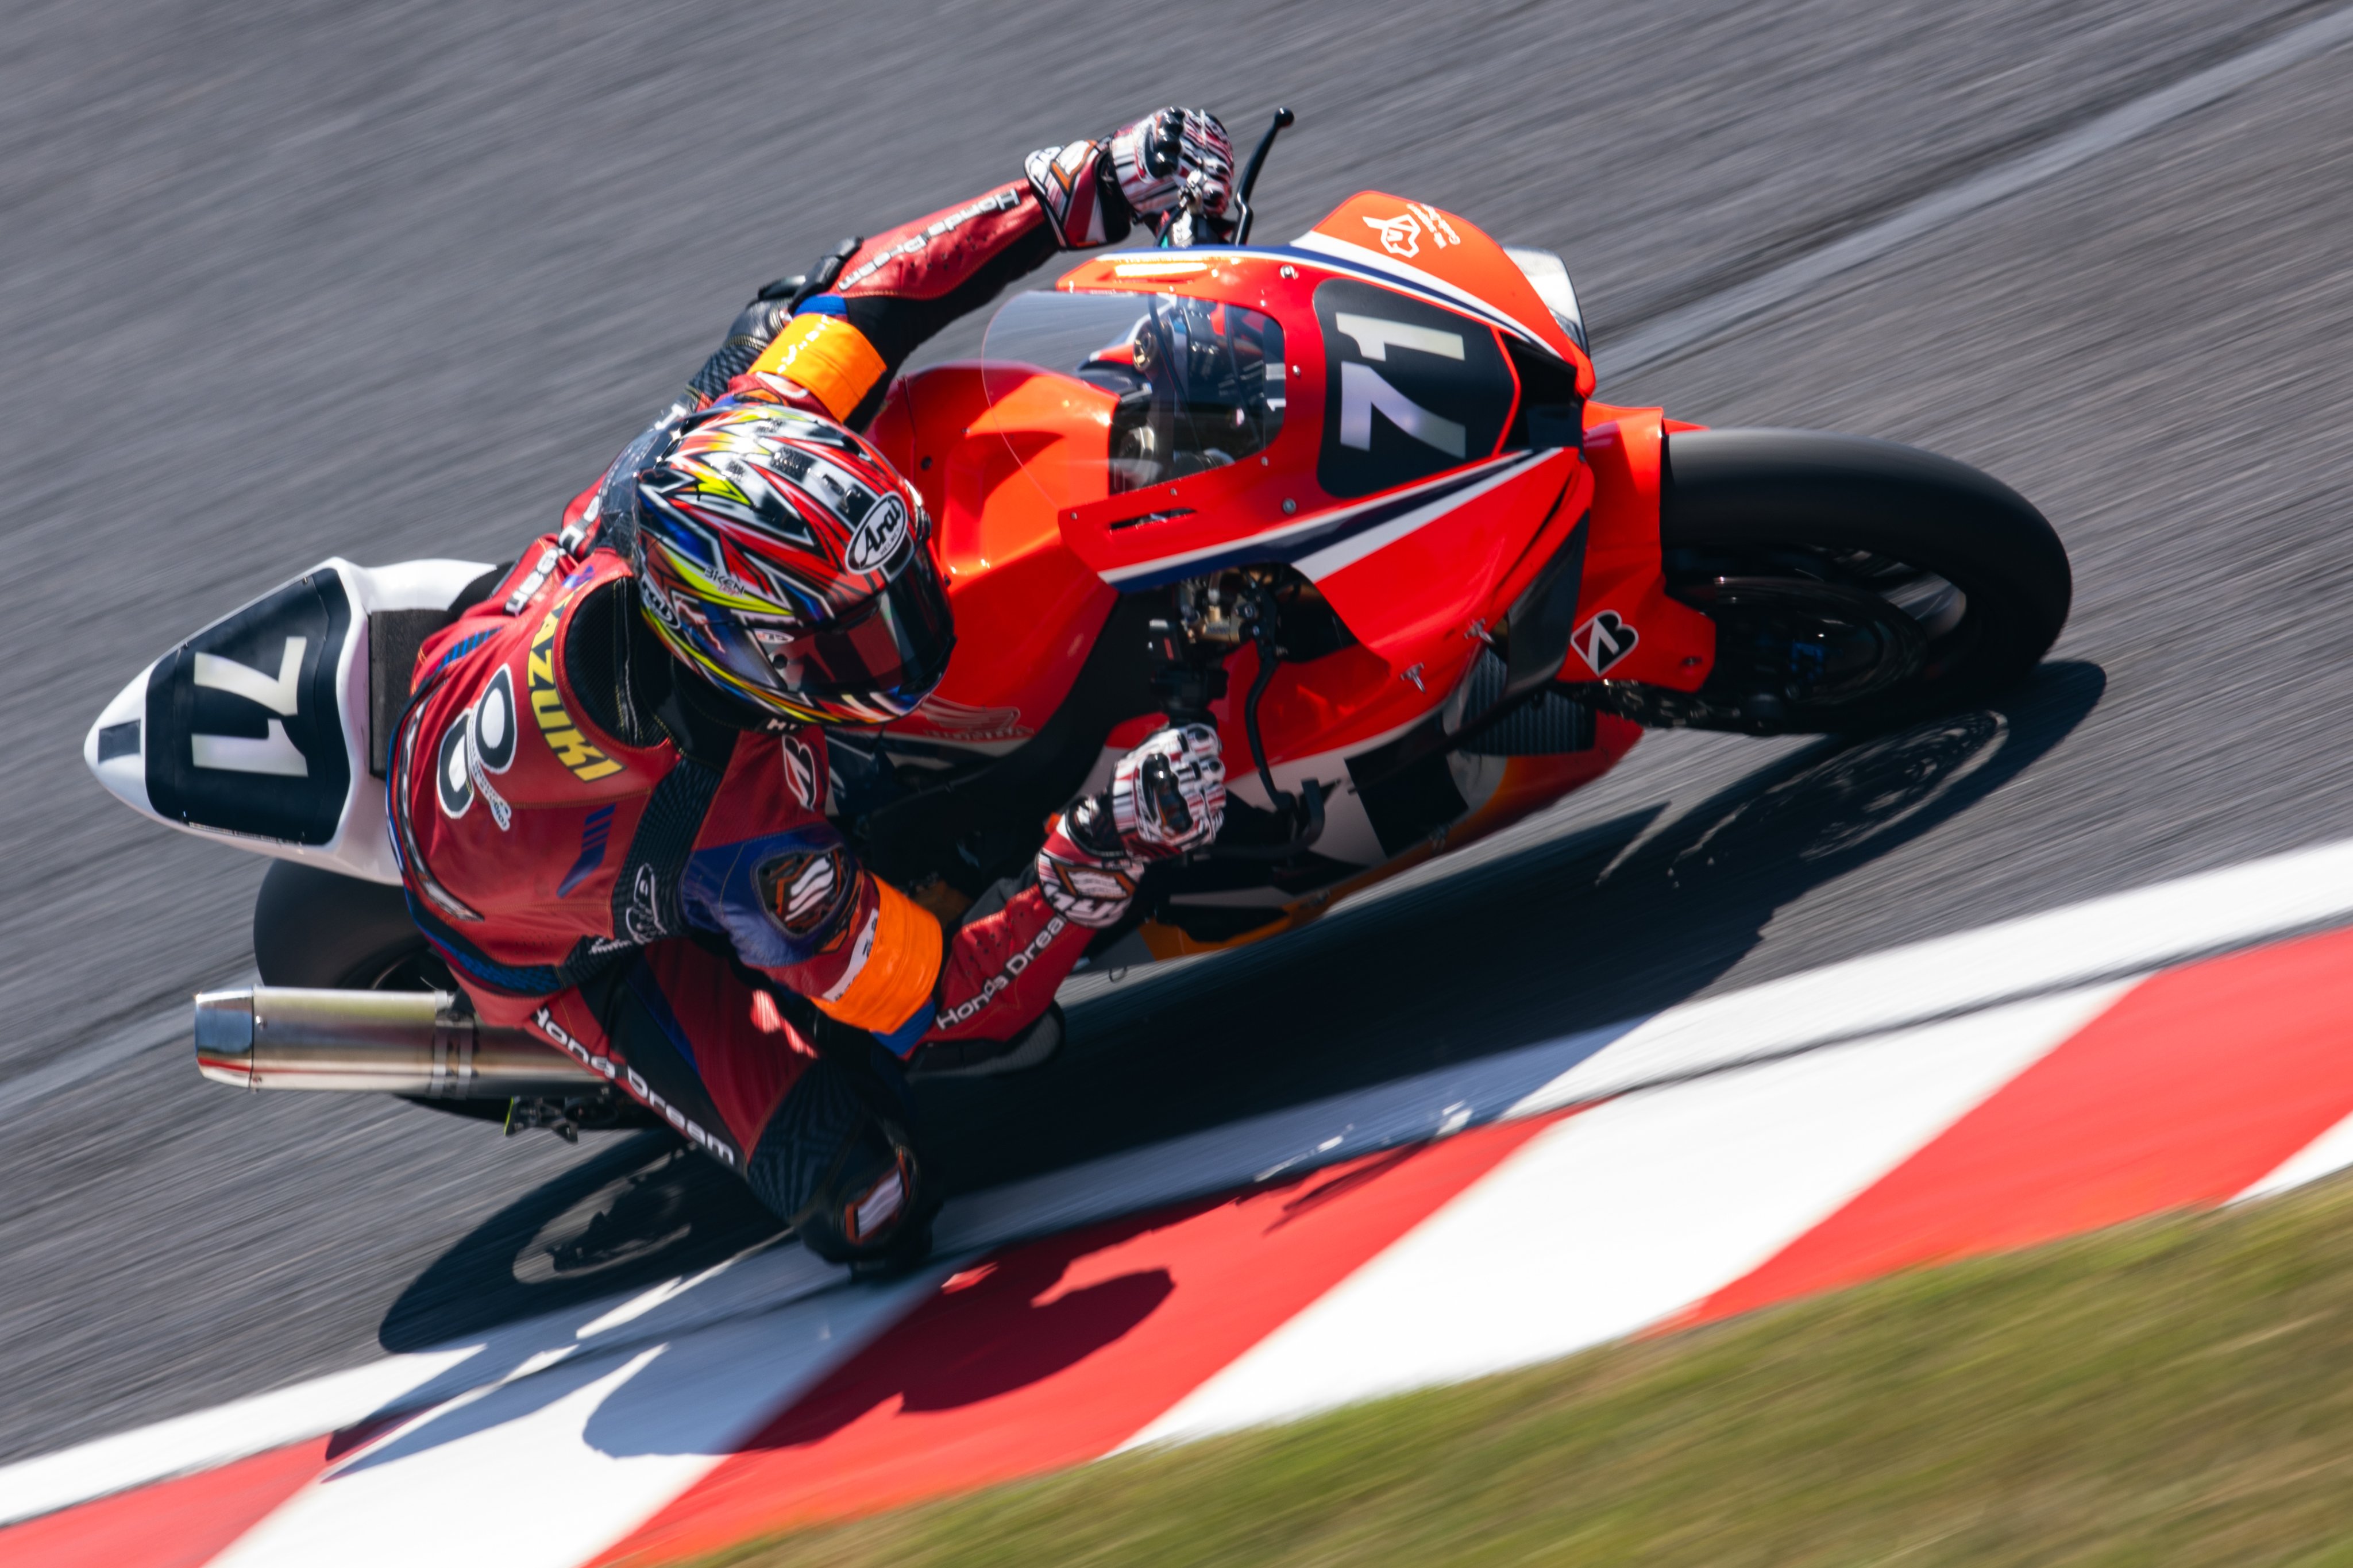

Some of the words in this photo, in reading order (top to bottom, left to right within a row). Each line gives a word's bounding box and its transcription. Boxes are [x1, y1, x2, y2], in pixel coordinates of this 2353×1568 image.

[838, 234, 927, 290] Dream
[927, 188, 1020, 240] Honda
[1336, 312, 1466, 459] 71
[504, 523, 586, 616] Deam
[860, 496, 901, 569] Arai
[191, 636, 308, 777] 71
[936, 975, 1009, 1030] Honda
[1006, 916, 1064, 975] Drea
[628, 1066, 734, 1166] Dream
